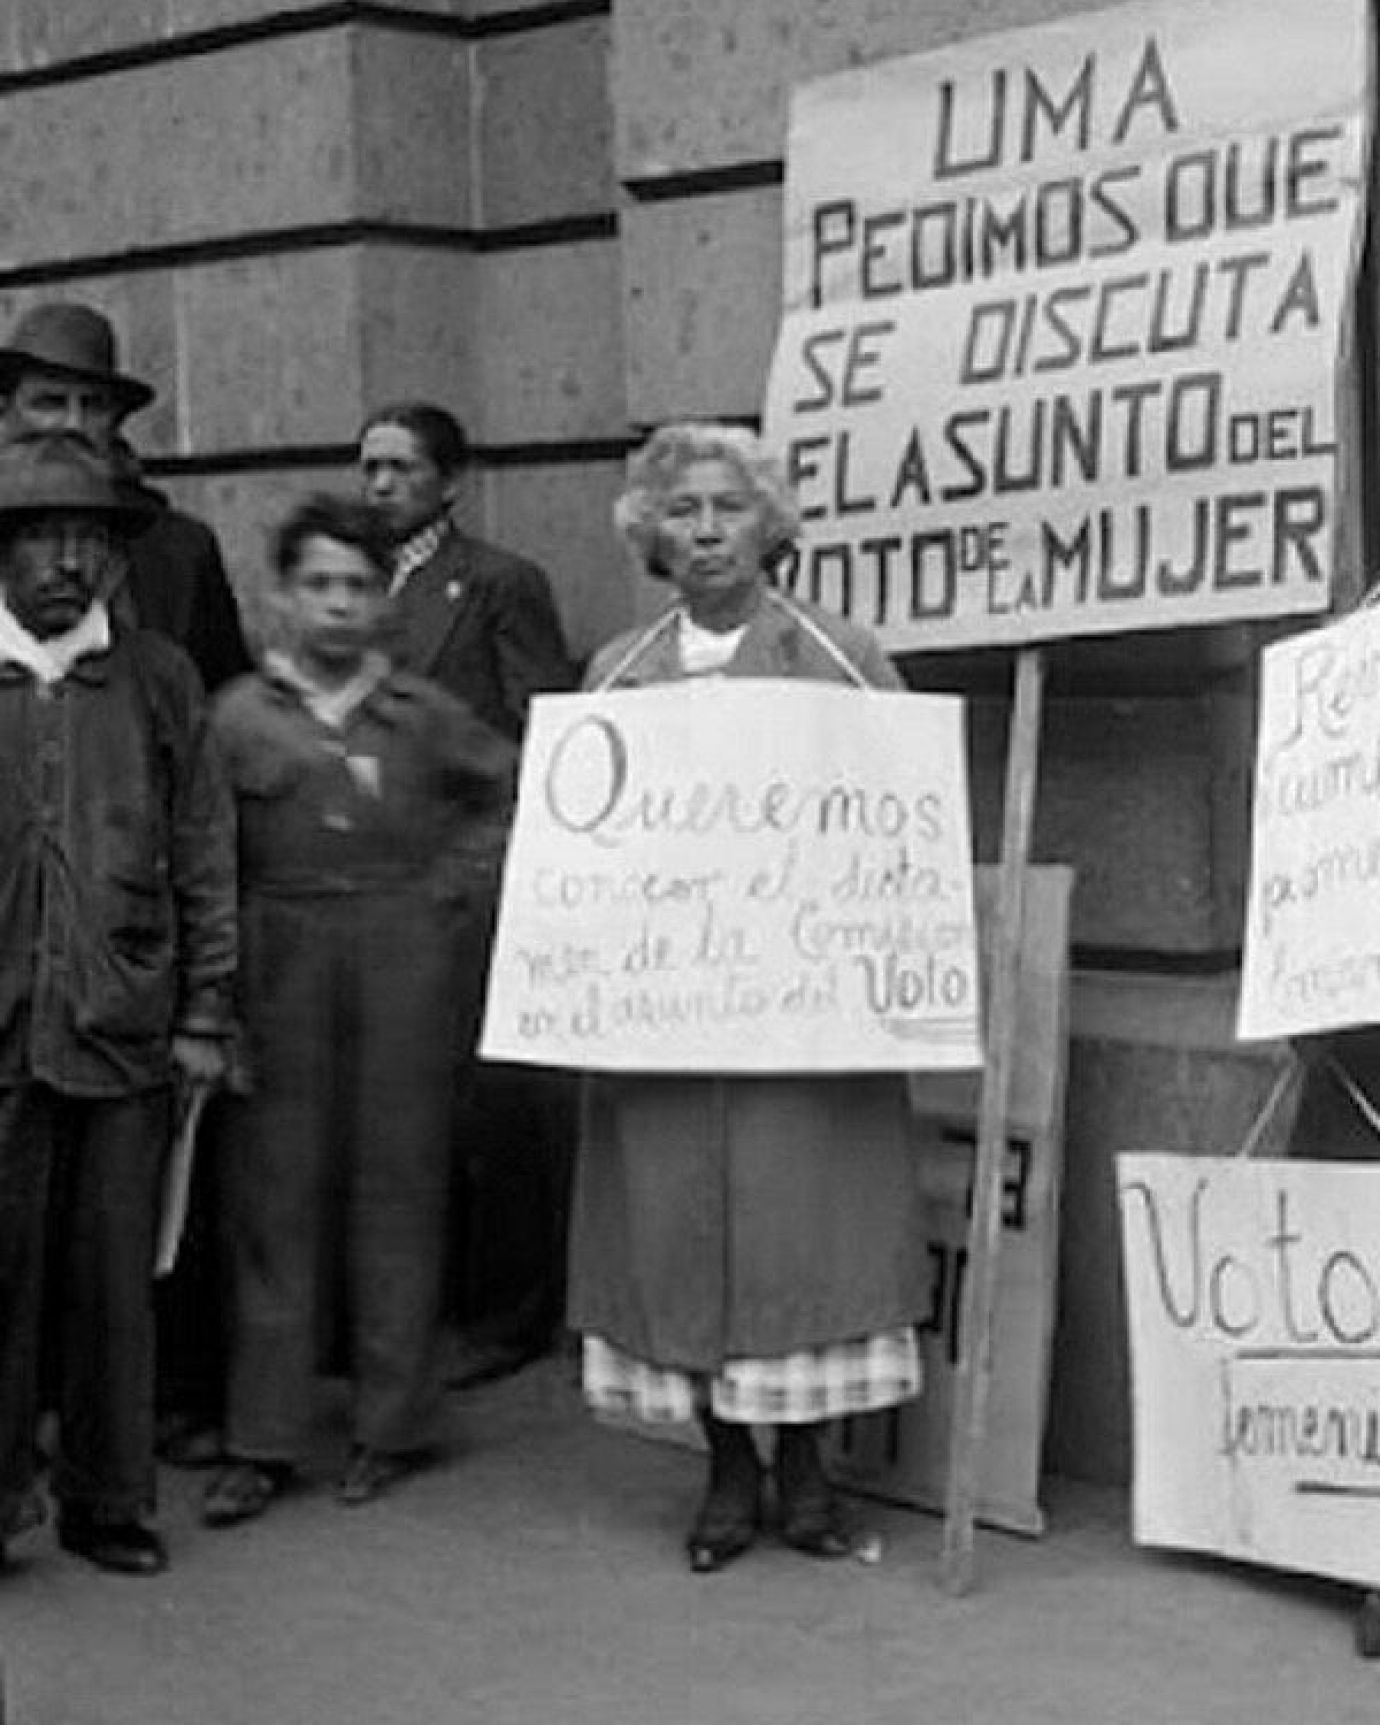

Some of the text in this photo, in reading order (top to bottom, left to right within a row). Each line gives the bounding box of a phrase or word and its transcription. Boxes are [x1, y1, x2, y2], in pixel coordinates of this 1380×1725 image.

[811, 126, 1343, 309] PEDIMOS QUE
[793, 253, 1320, 413] SE DISCUTA
[788, 372, 1338, 521] EL ASUNTO DEL
[960, 521, 1010, 572] DE
[1041, 487, 1325, 610] MUJER
[545, 713, 942, 848] Queremos
[622, 918, 680, 973] de
[692, 896, 759, 967] la
[747, 838, 799, 899] el
